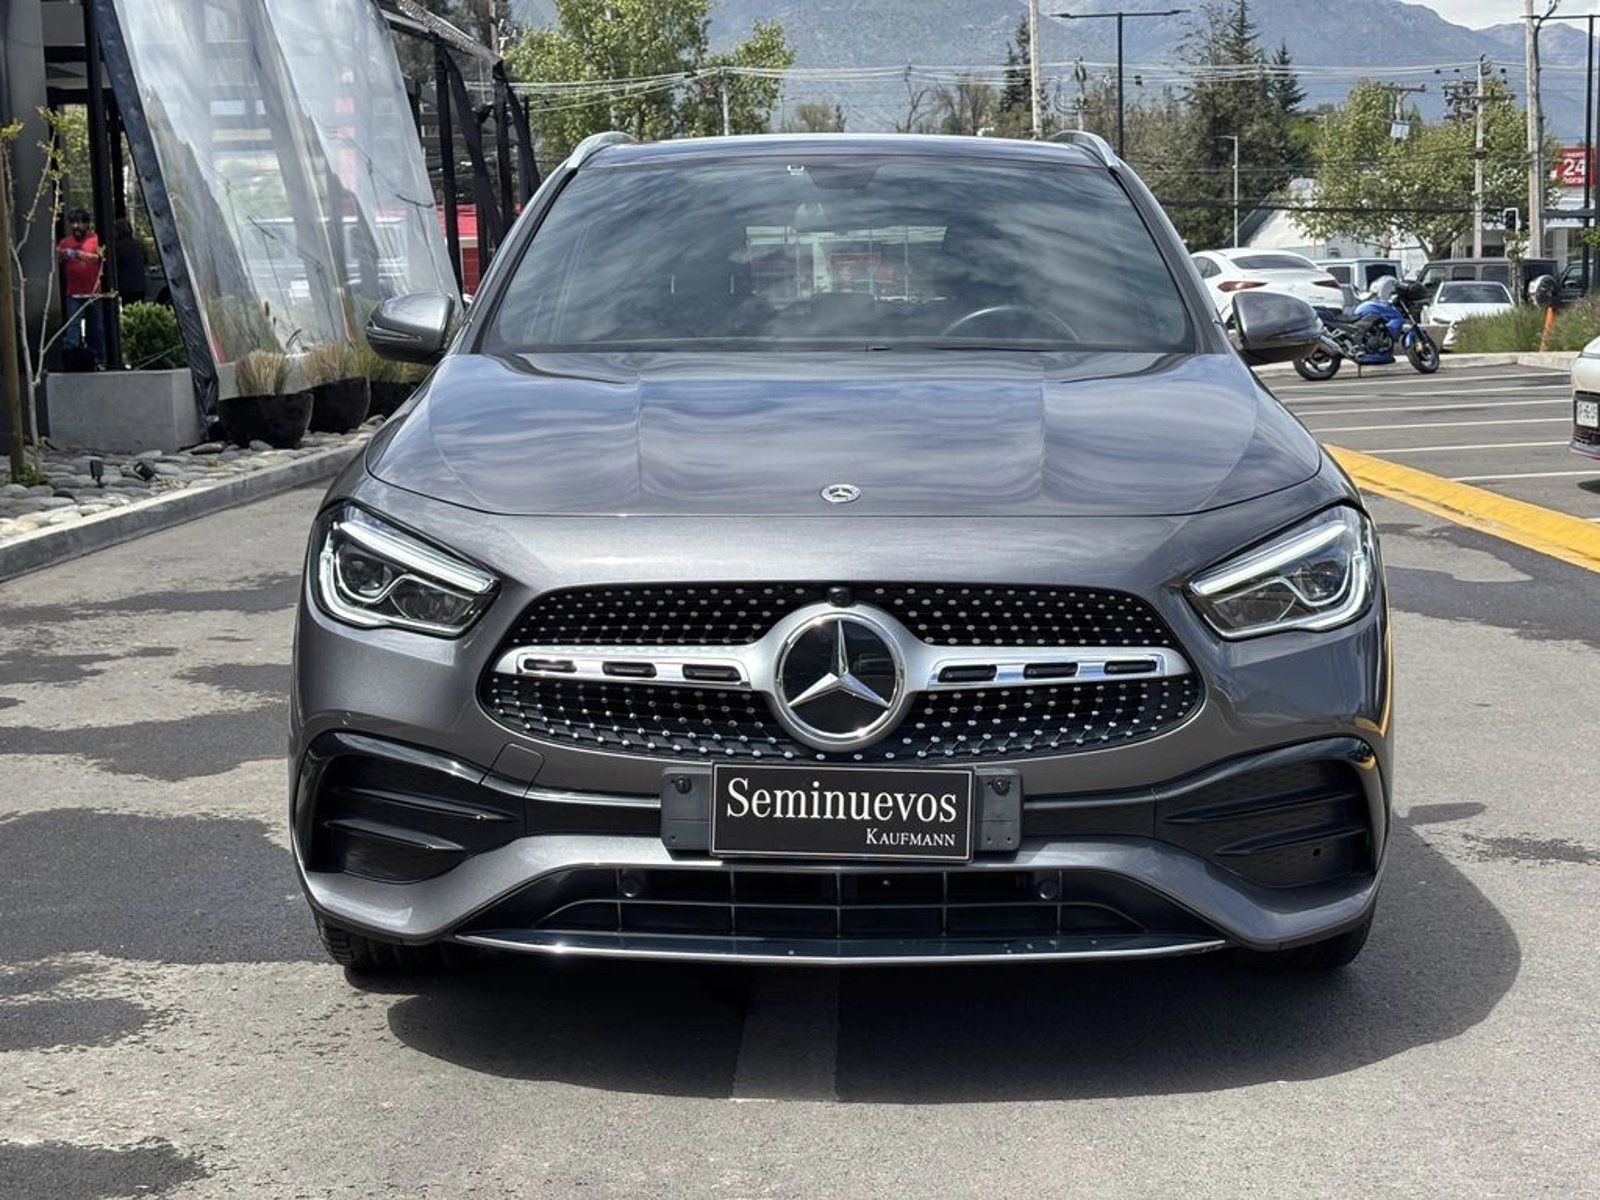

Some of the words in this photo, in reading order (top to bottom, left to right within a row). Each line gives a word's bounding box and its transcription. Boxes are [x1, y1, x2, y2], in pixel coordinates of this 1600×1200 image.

[1563, 158, 1586, 176] 24
[727, 777, 957, 823] Seminuevos
[865, 827, 956, 846] KAUFMANN
